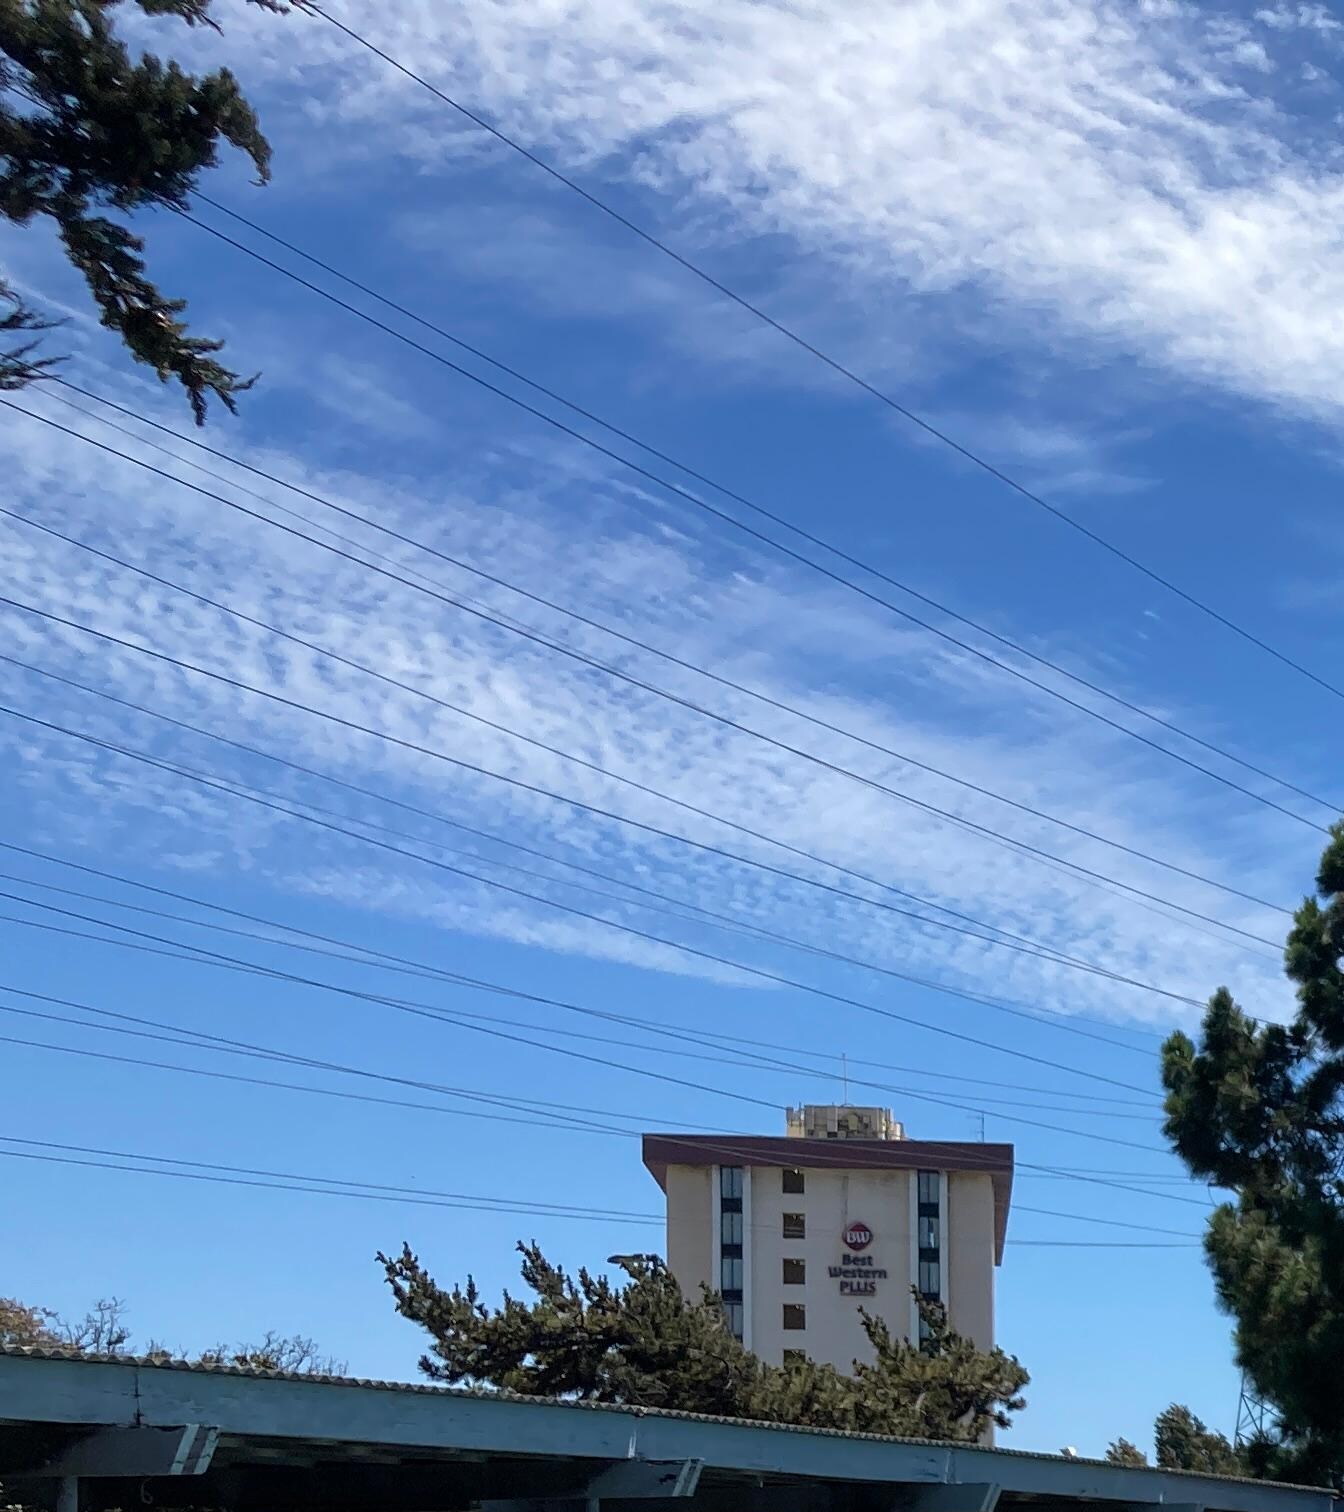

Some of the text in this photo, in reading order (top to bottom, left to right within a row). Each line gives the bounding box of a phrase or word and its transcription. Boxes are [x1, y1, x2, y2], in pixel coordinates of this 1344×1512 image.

[842, 1254, 873, 1266] Best
[828, 1266, 887, 1279] Western
[840, 1281, 876, 1293] PLUS
